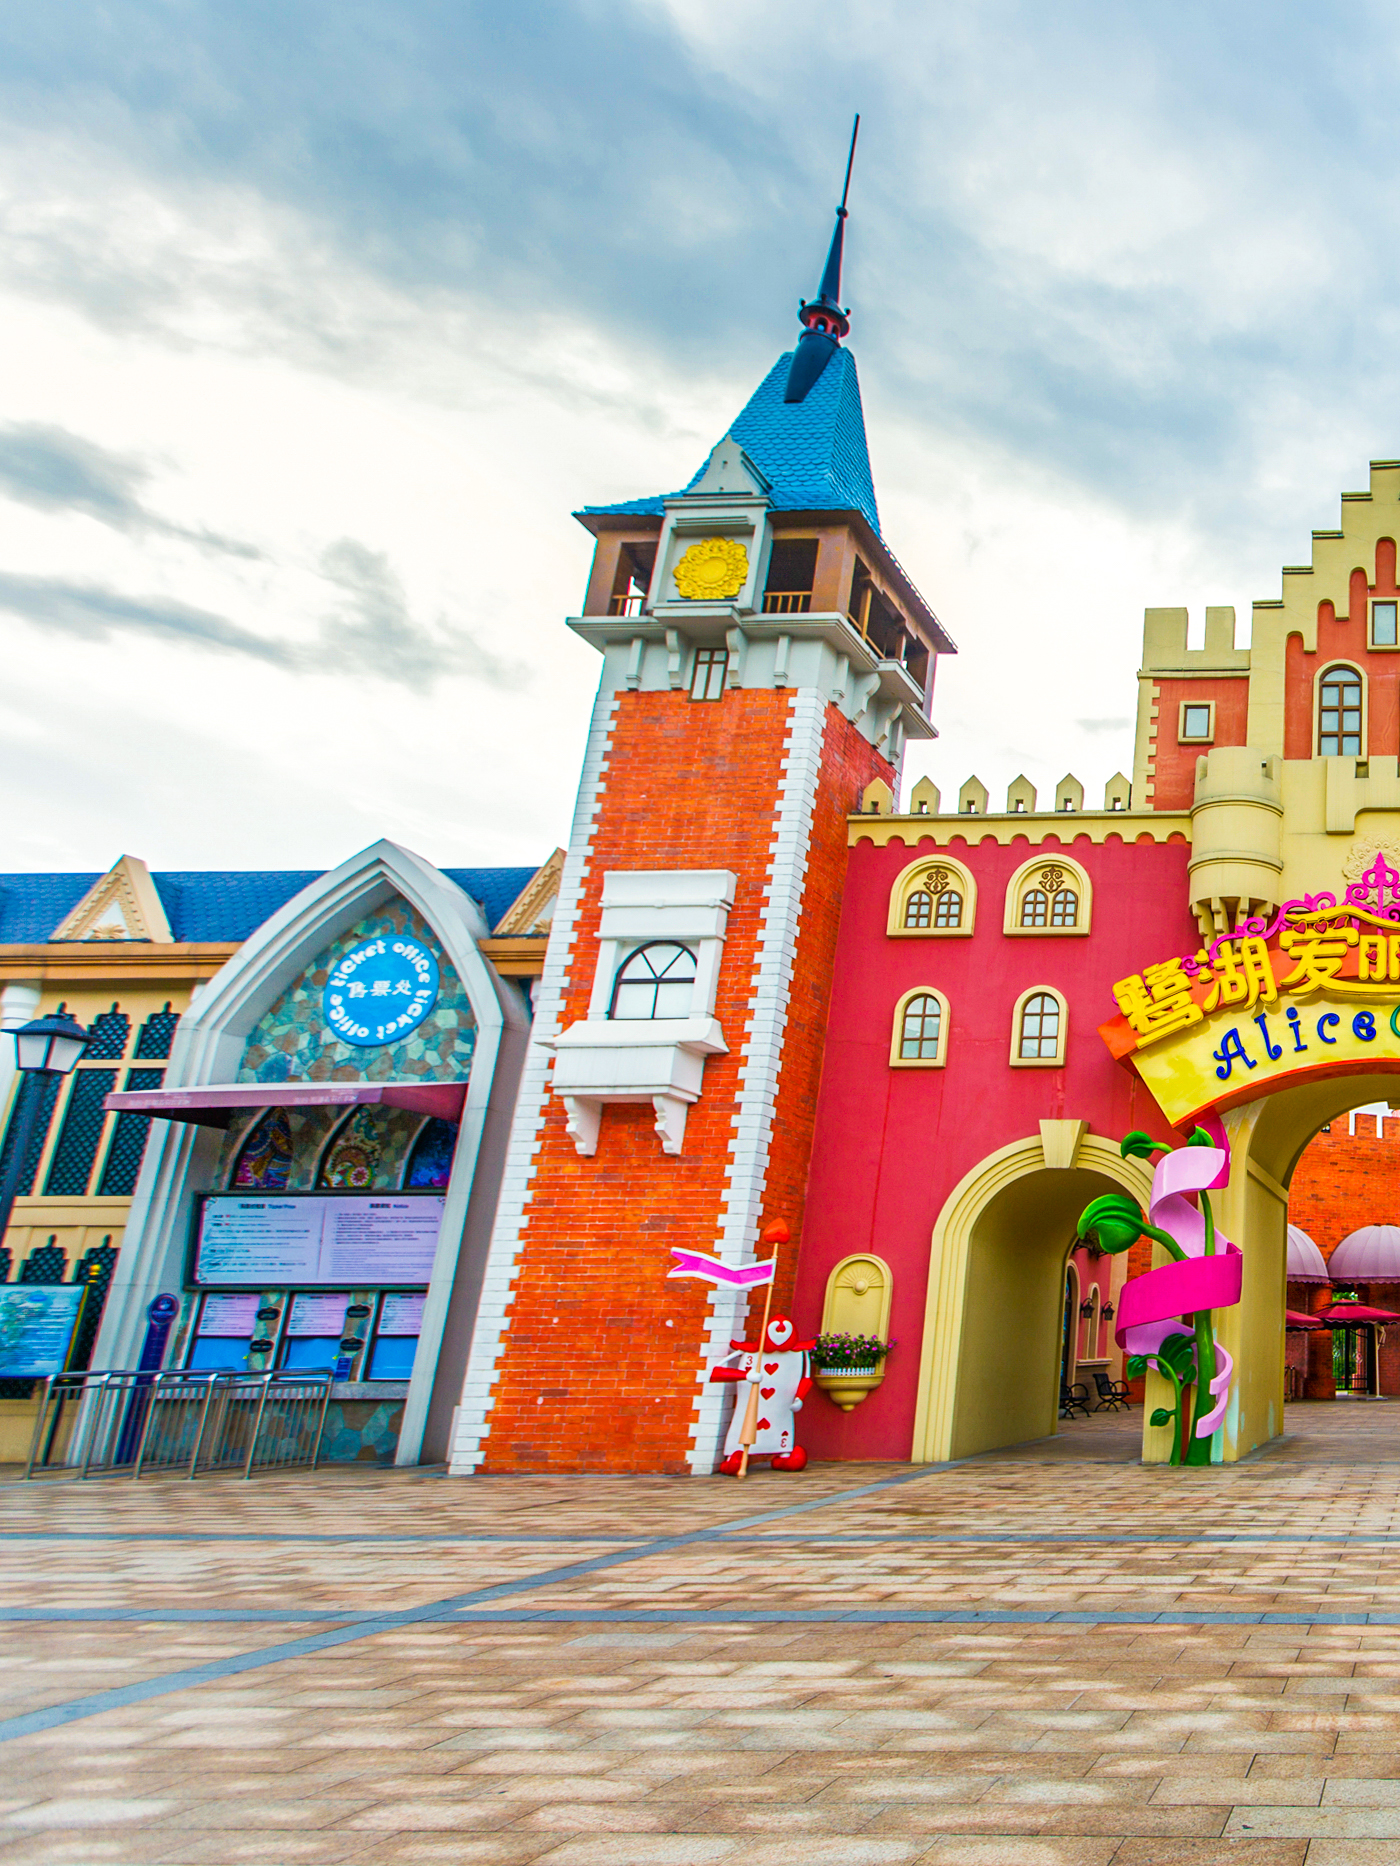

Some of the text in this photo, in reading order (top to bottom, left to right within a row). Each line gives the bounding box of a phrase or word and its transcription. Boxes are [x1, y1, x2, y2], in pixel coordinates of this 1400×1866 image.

[330, 940, 431, 987] ticket office
[346, 979, 412, 999] 售票处
[329, 989, 432, 1040] ticket office
[1213, 1006, 1377, 1080] Alice
[746, 1355, 754, 1366] 3
